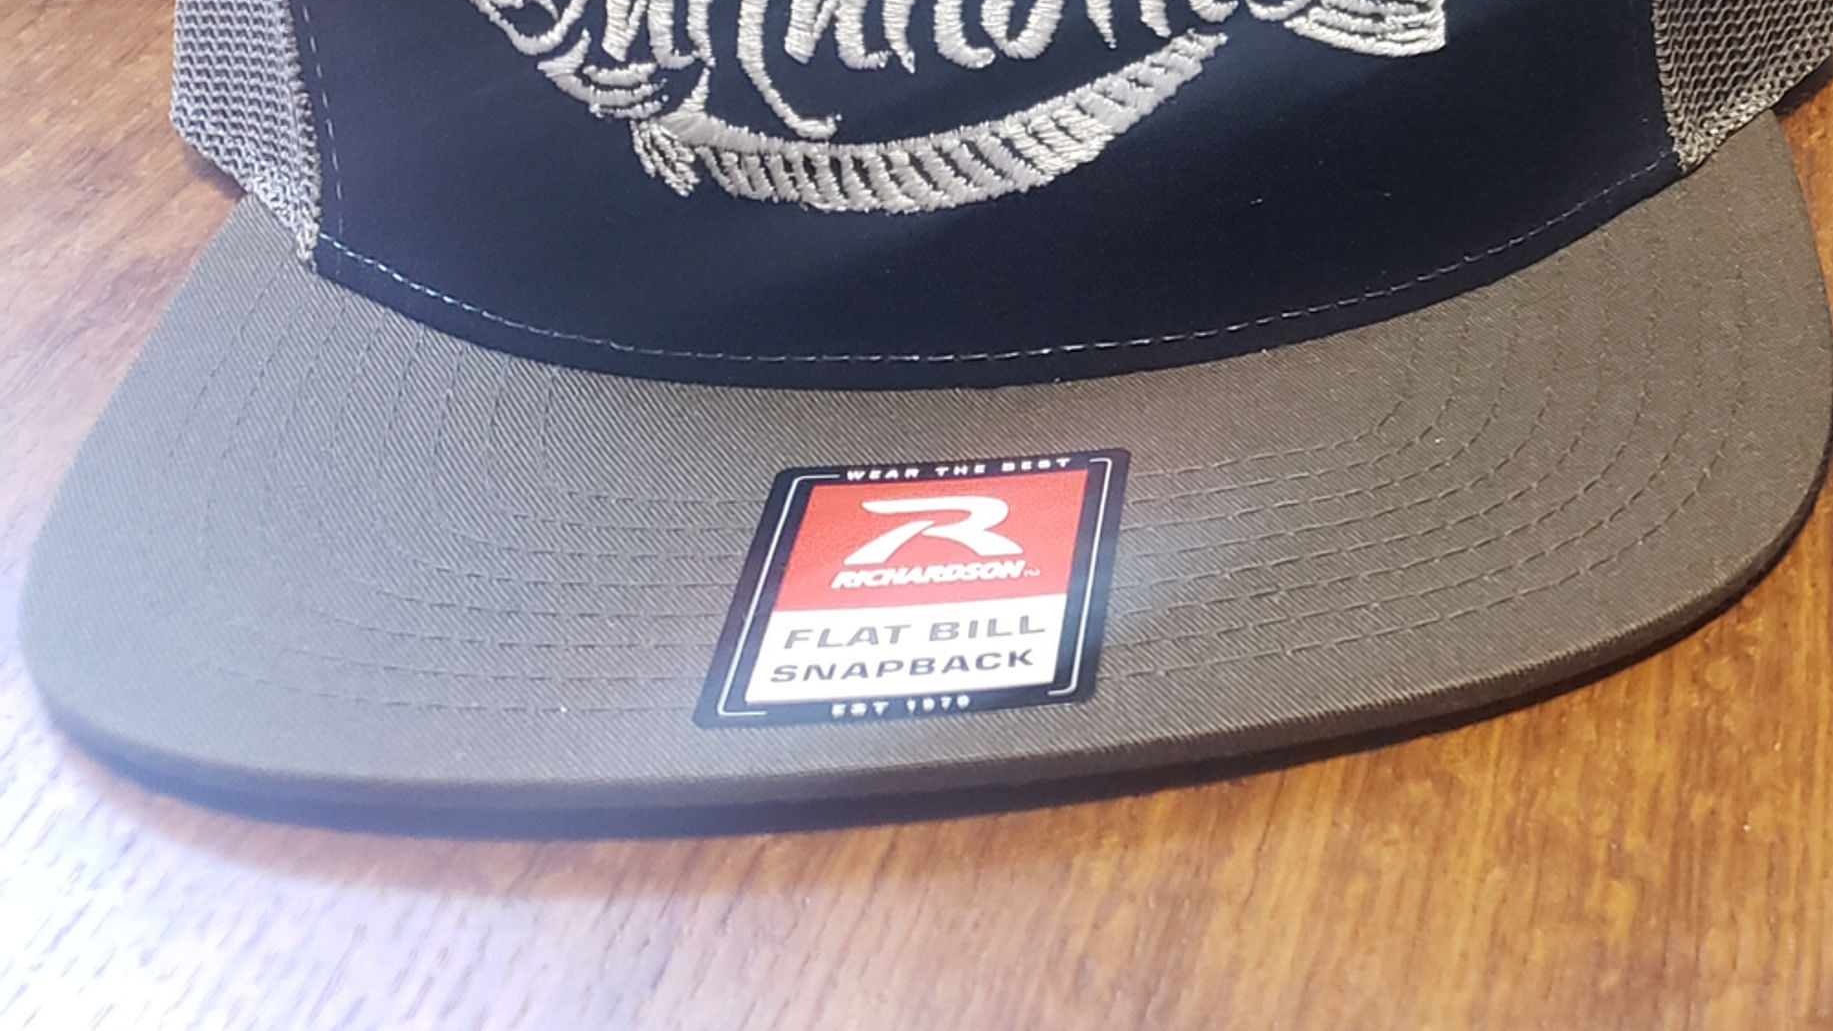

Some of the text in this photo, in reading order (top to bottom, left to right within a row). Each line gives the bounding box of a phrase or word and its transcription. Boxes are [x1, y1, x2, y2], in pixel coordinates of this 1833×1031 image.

[846, 457, 1071, 480] WEAR THE BEST
[830, 559, 1026, 589] RICHARDSON
[783, 615, 1046, 649] FLAT BILL
[770, 648, 1035, 683] SNAPBACK
[830, 700, 889, 718] EST
